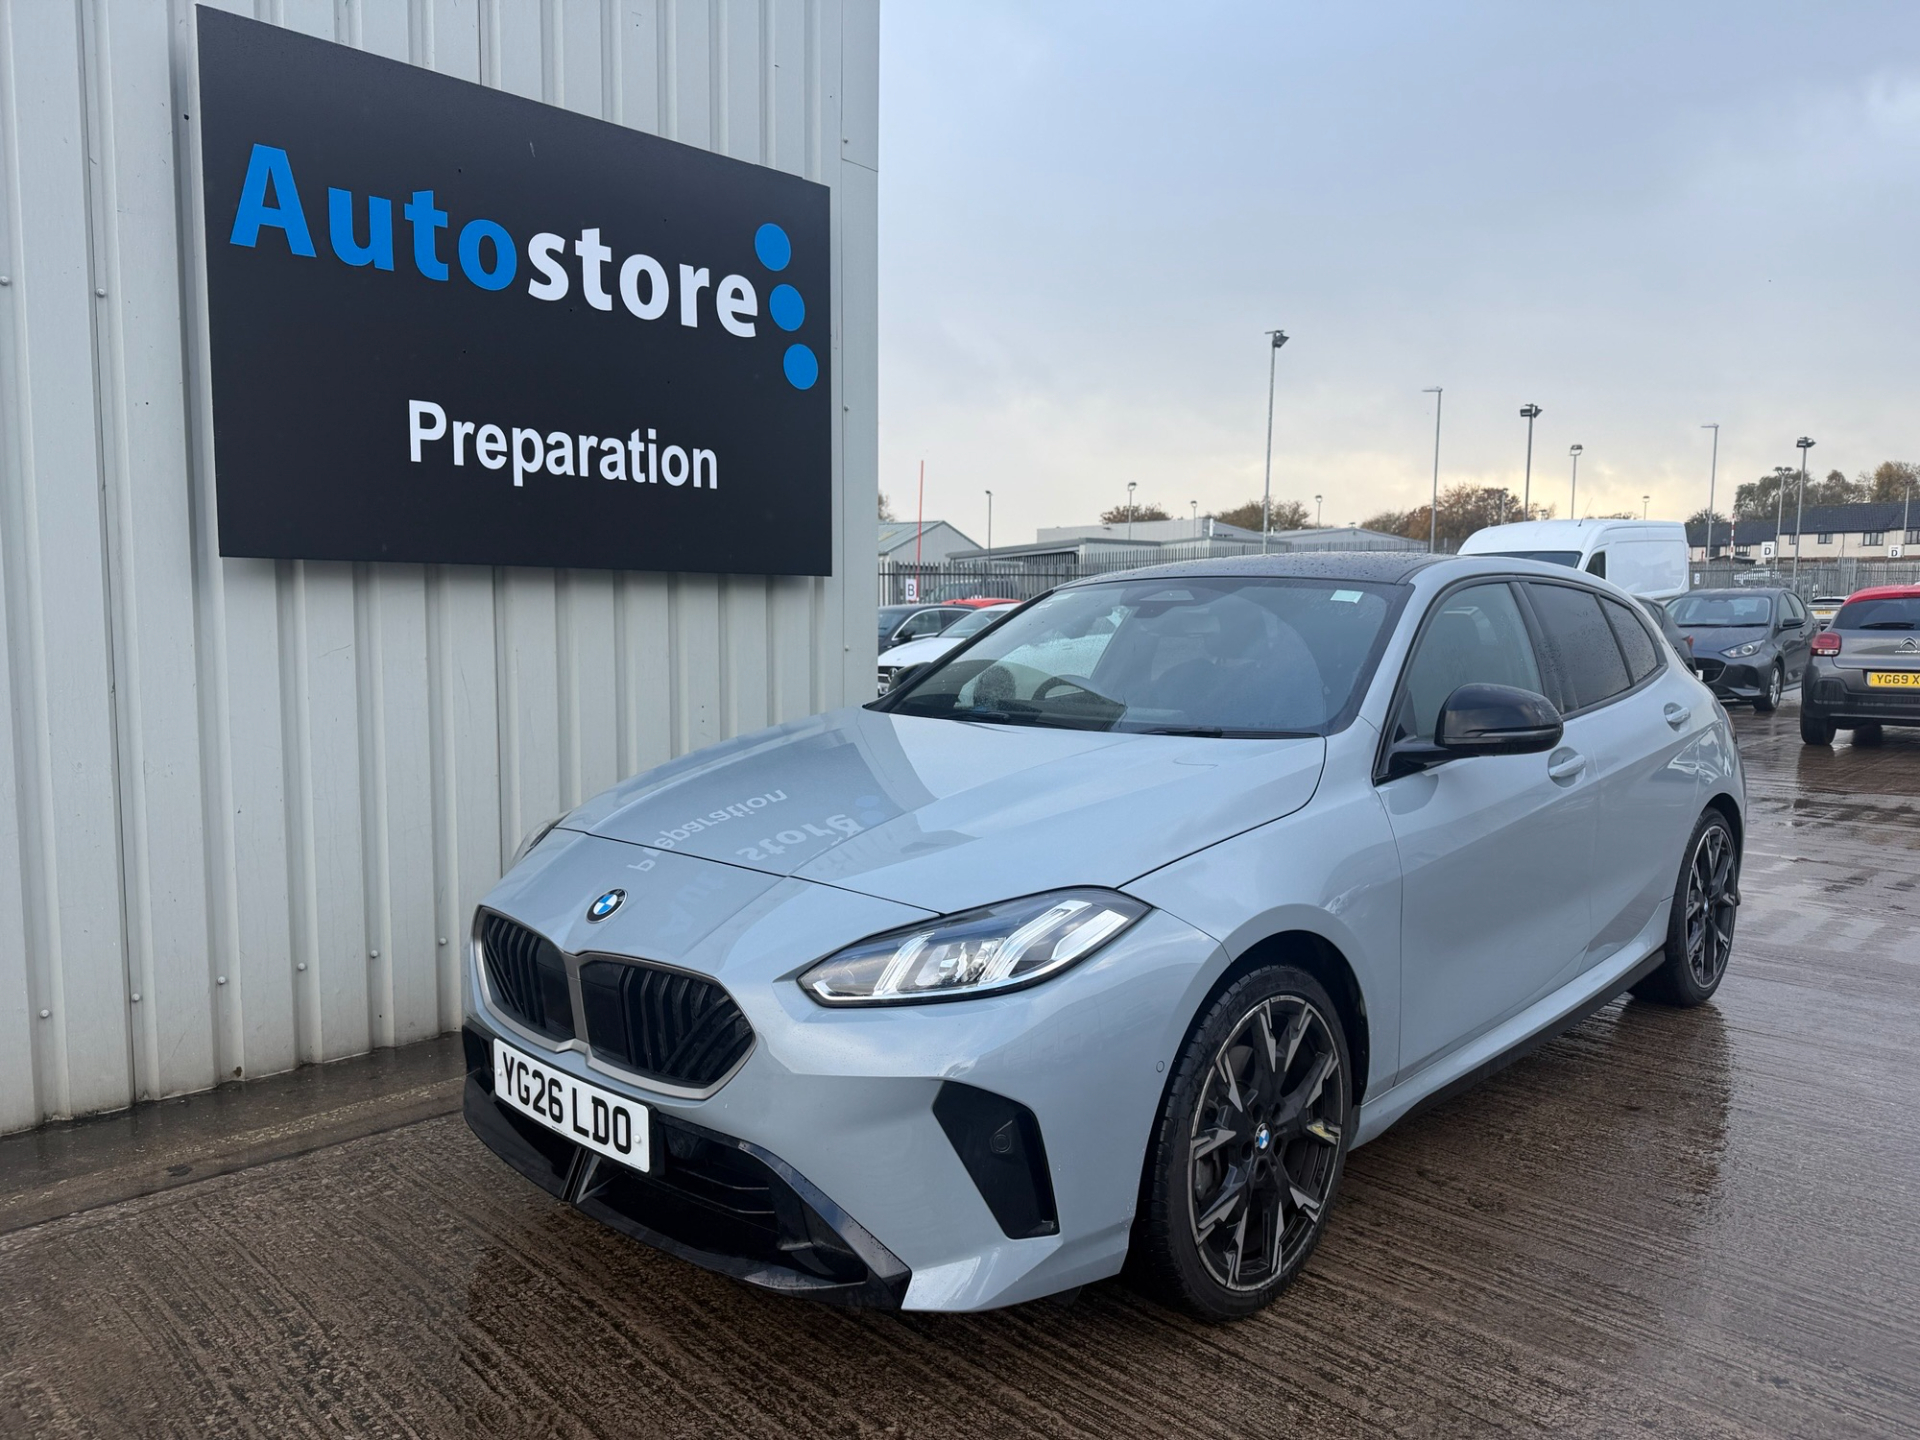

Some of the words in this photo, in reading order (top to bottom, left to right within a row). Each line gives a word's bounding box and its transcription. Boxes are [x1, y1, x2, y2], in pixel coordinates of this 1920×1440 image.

[229, 143, 758, 338] Autostore
[408, 399, 718, 489] Preparation
[1764, 546, 1772, 556] D
[1891, 549, 1898, 557] D
[907, 583, 915, 597] B
[1876, 674, 1909, 685] YG69
[502, 1051, 564, 1124] YG26
[571, 1087, 632, 1155] LDO
